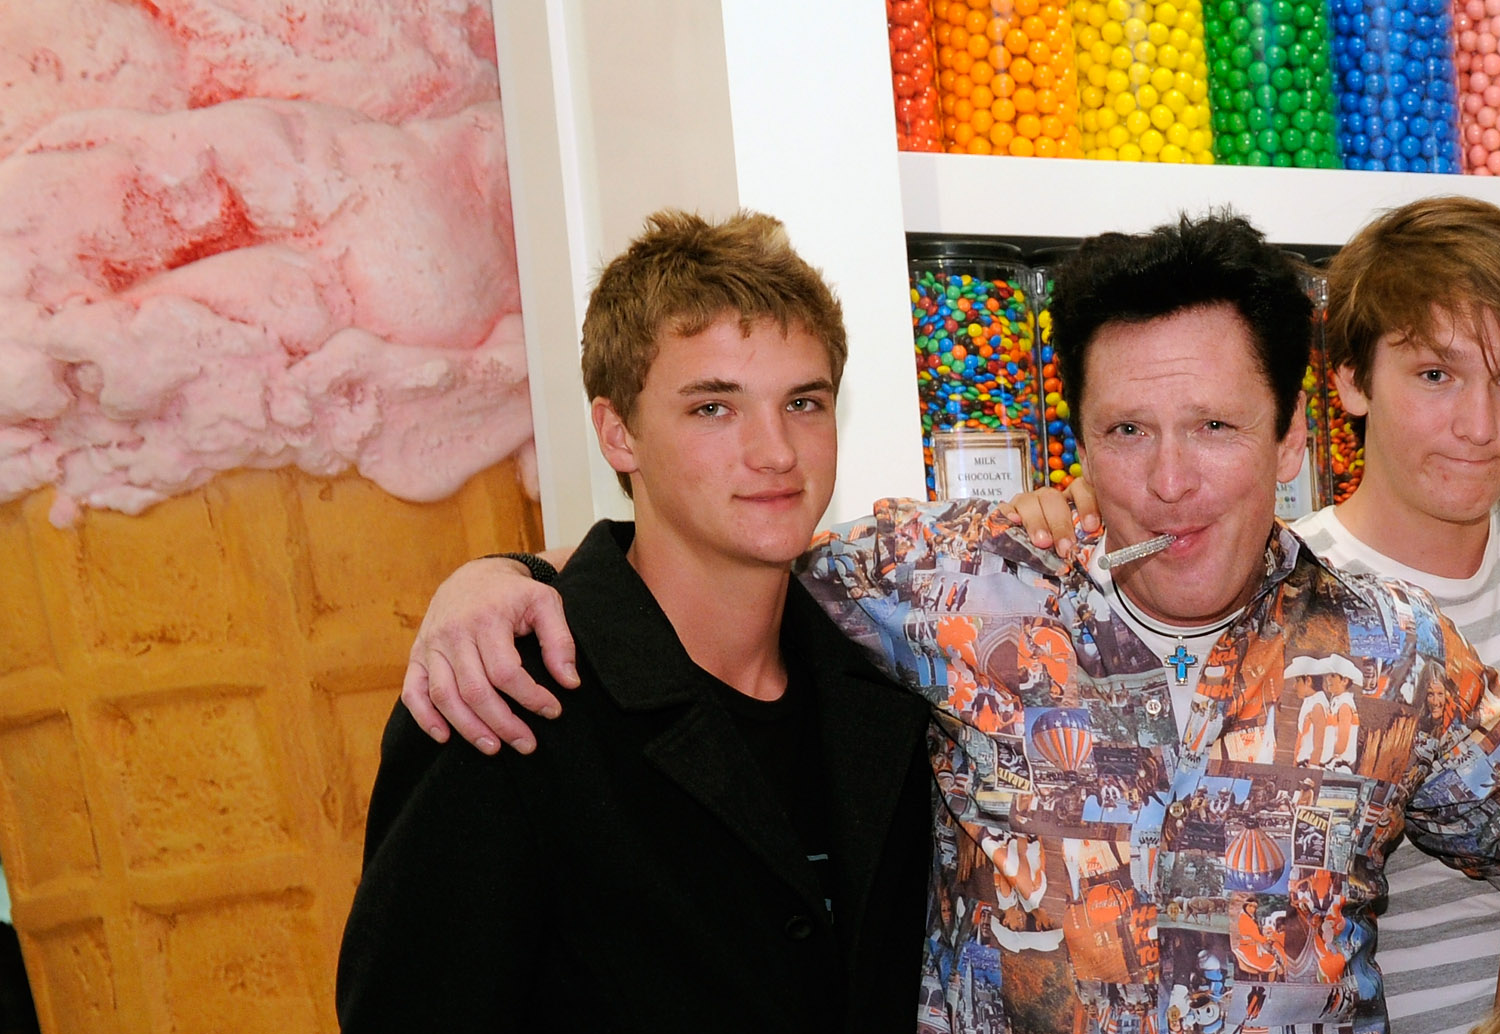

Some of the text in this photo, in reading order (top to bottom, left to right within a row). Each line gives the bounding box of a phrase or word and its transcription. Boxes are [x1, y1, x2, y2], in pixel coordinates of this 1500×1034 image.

[974, 457, 996, 465] MILK
[957, 472, 1012, 481] CHOCOLATE
[972, 488, 1002, 496] M&M'S
[1297, 809, 1329, 831] KARATE
